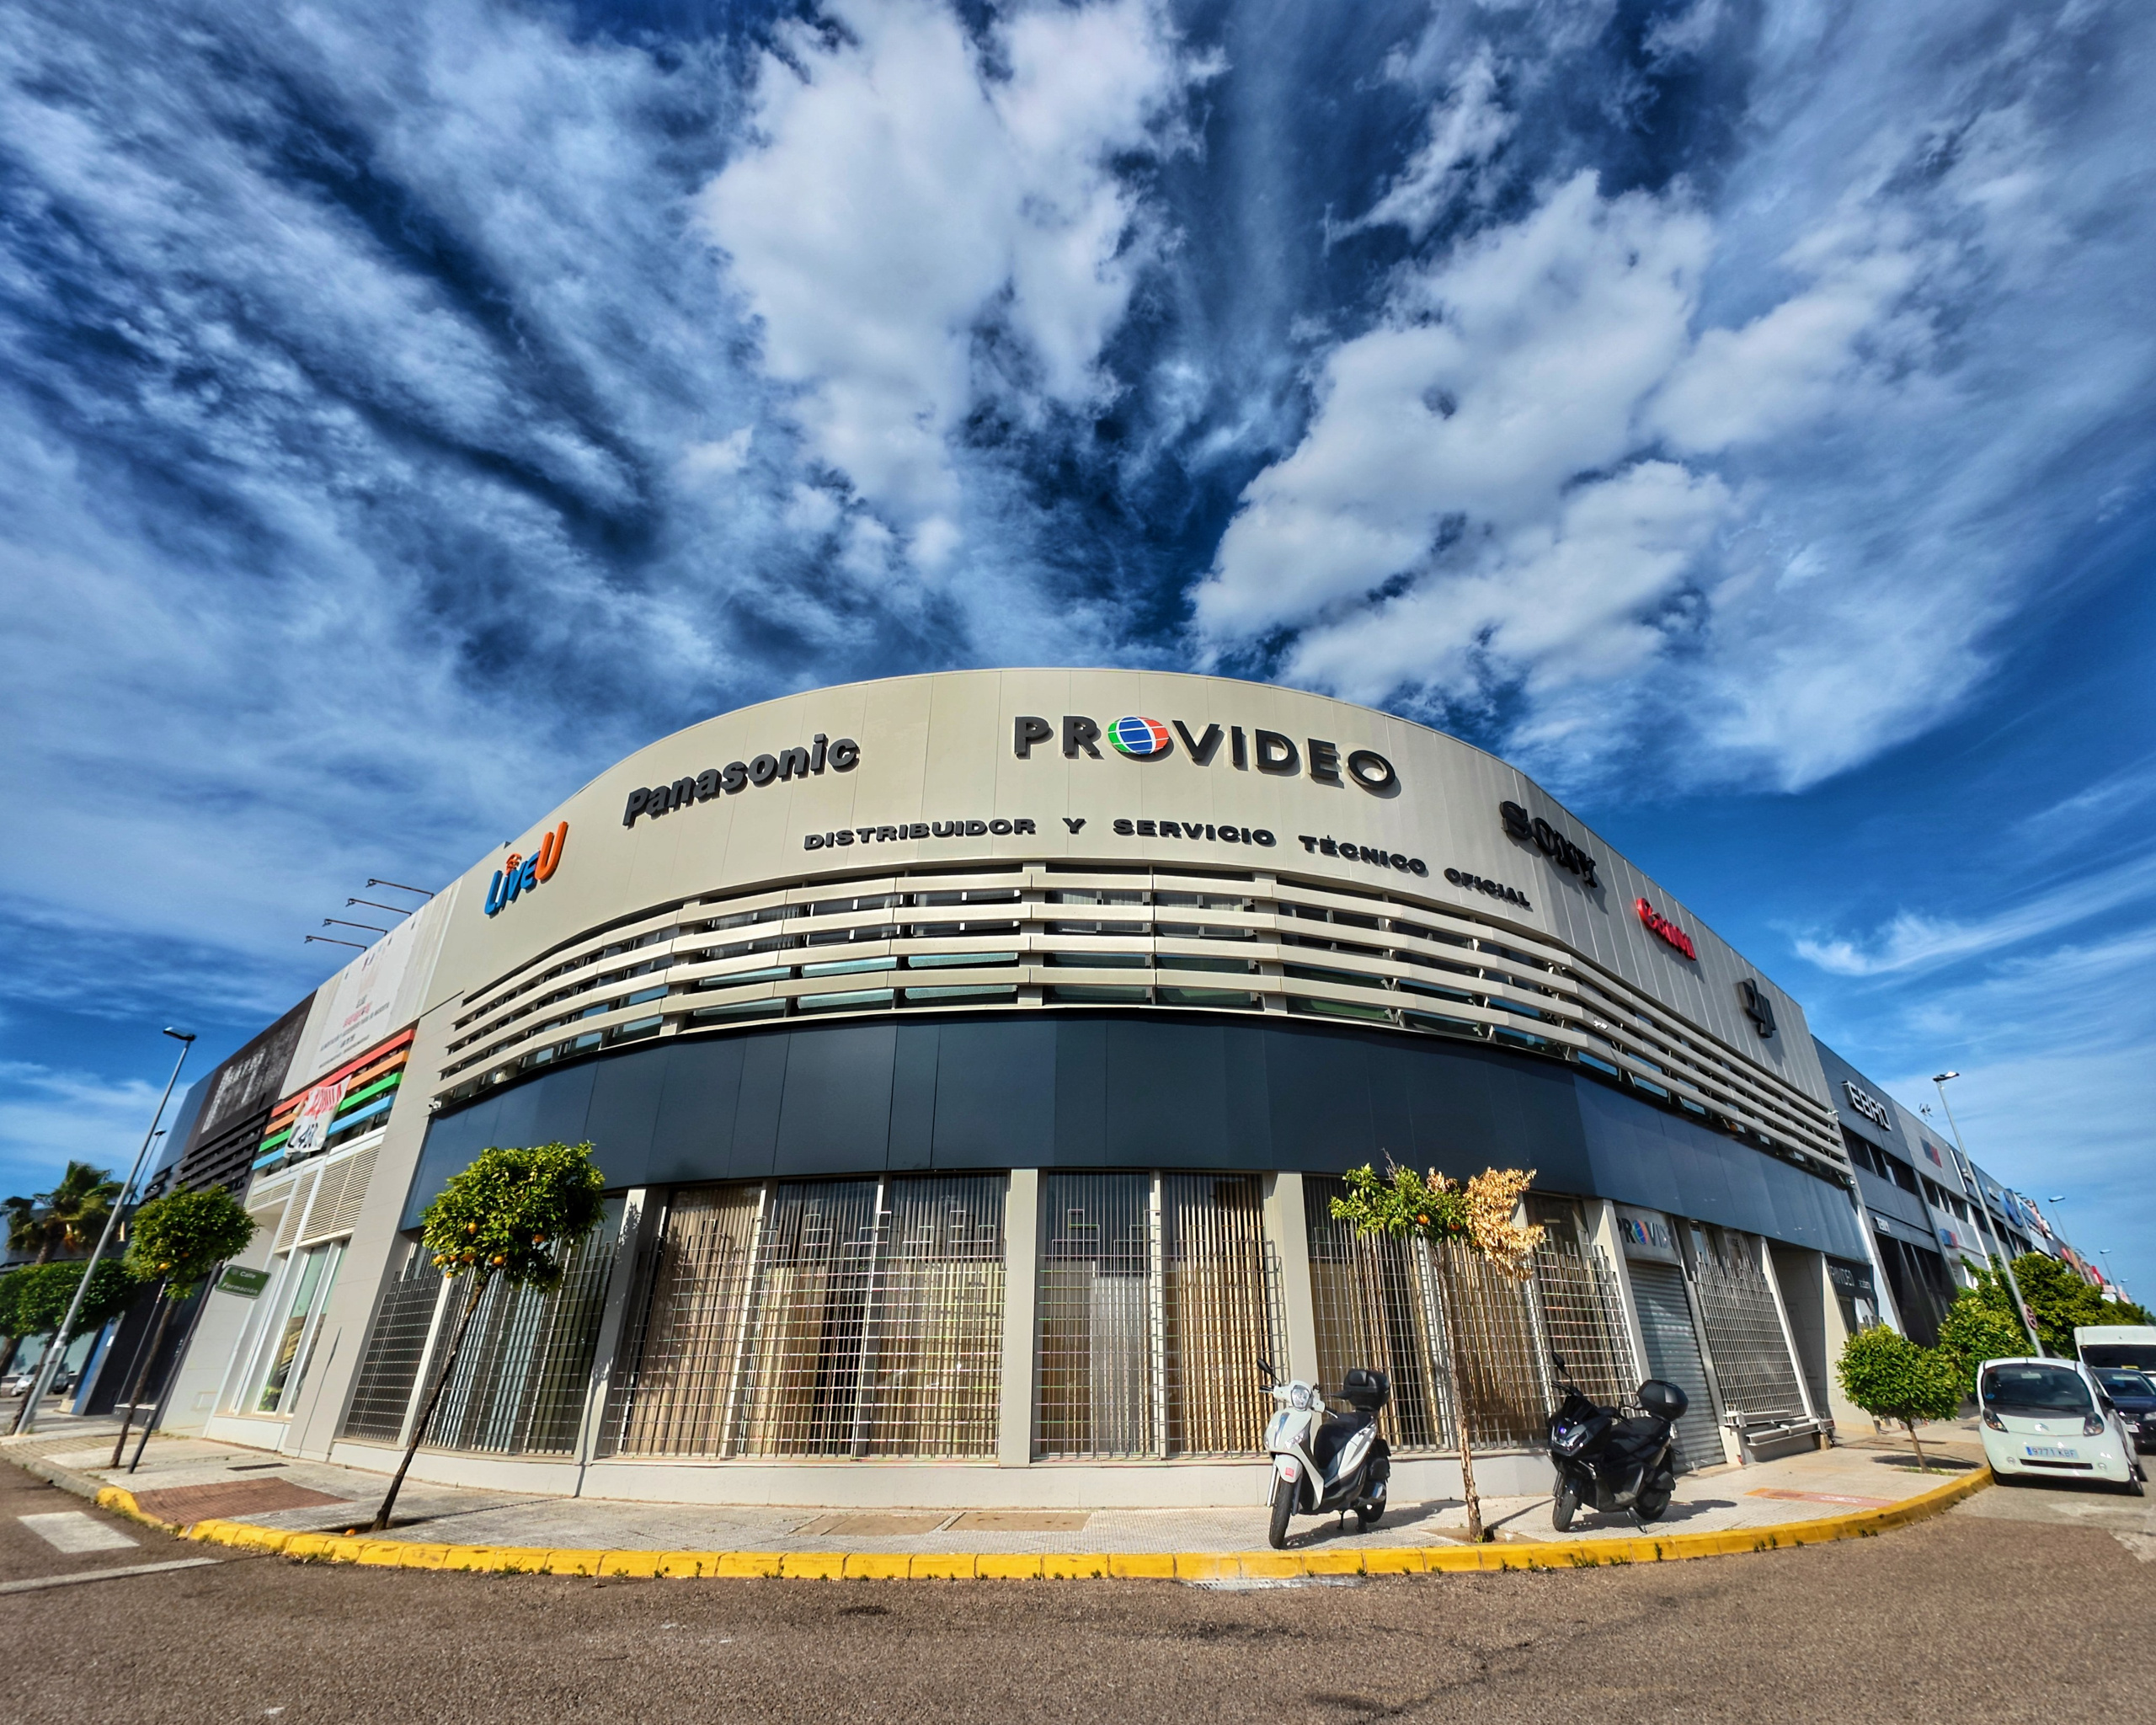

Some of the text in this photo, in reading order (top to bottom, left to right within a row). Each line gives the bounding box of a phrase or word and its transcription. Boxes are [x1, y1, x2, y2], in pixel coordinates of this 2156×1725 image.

[622, 733, 860, 828] Panasonic
[1013, 715, 1399, 793] PROVIDEO
[803, 818, 1532, 908] DISTRIBUIDOR Y SERVICIO TÉCNICO OFICIAL
[1500, 800, 1598, 889] SONY
[222, 1282, 258, 1294] Formación
[240, 1271, 256, 1279] Calle
[2032, 1447, 2055, 1457] 9771
